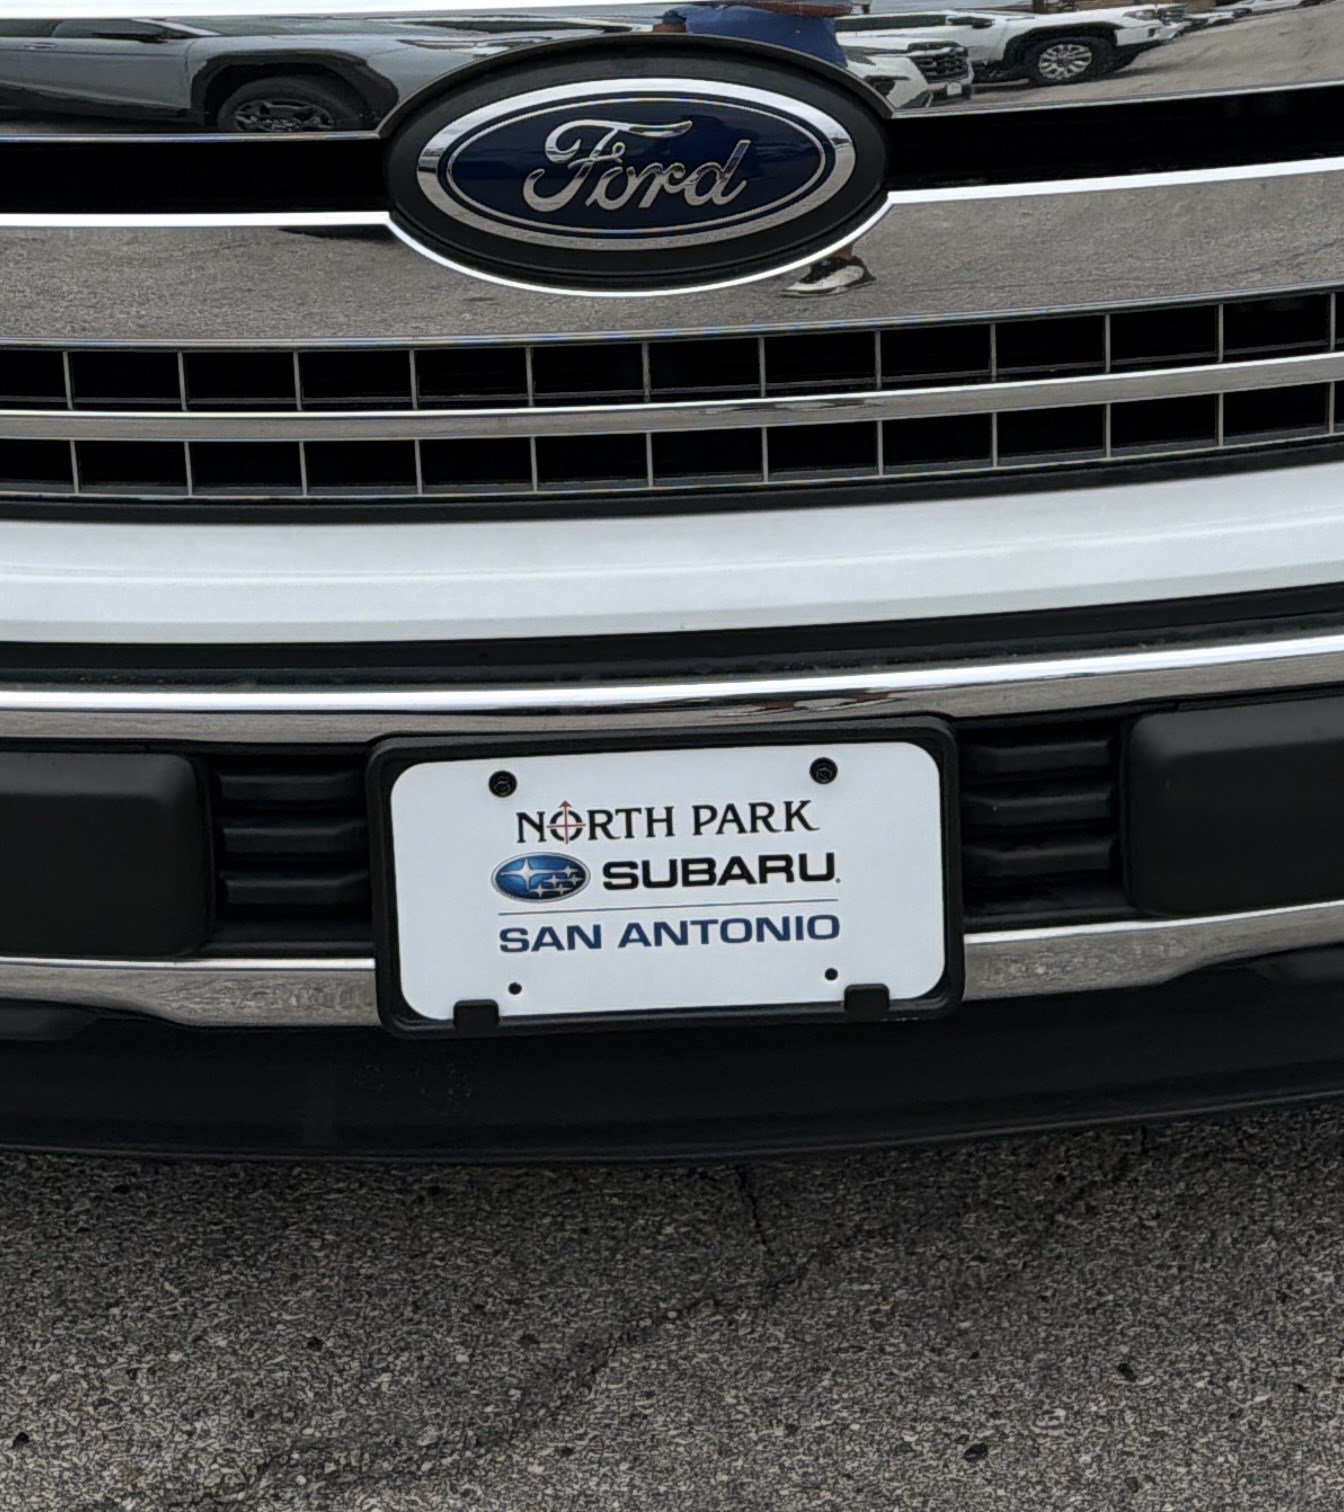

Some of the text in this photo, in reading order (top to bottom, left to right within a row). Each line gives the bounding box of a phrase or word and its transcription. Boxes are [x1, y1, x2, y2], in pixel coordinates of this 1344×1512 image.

[522, 118, 752, 213] Ford
[515, 799, 820, 844] NORTH PARK
[602, 851, 837, 891] SUBARU
[499, 914, 841, 953] SAN ANTONIO
